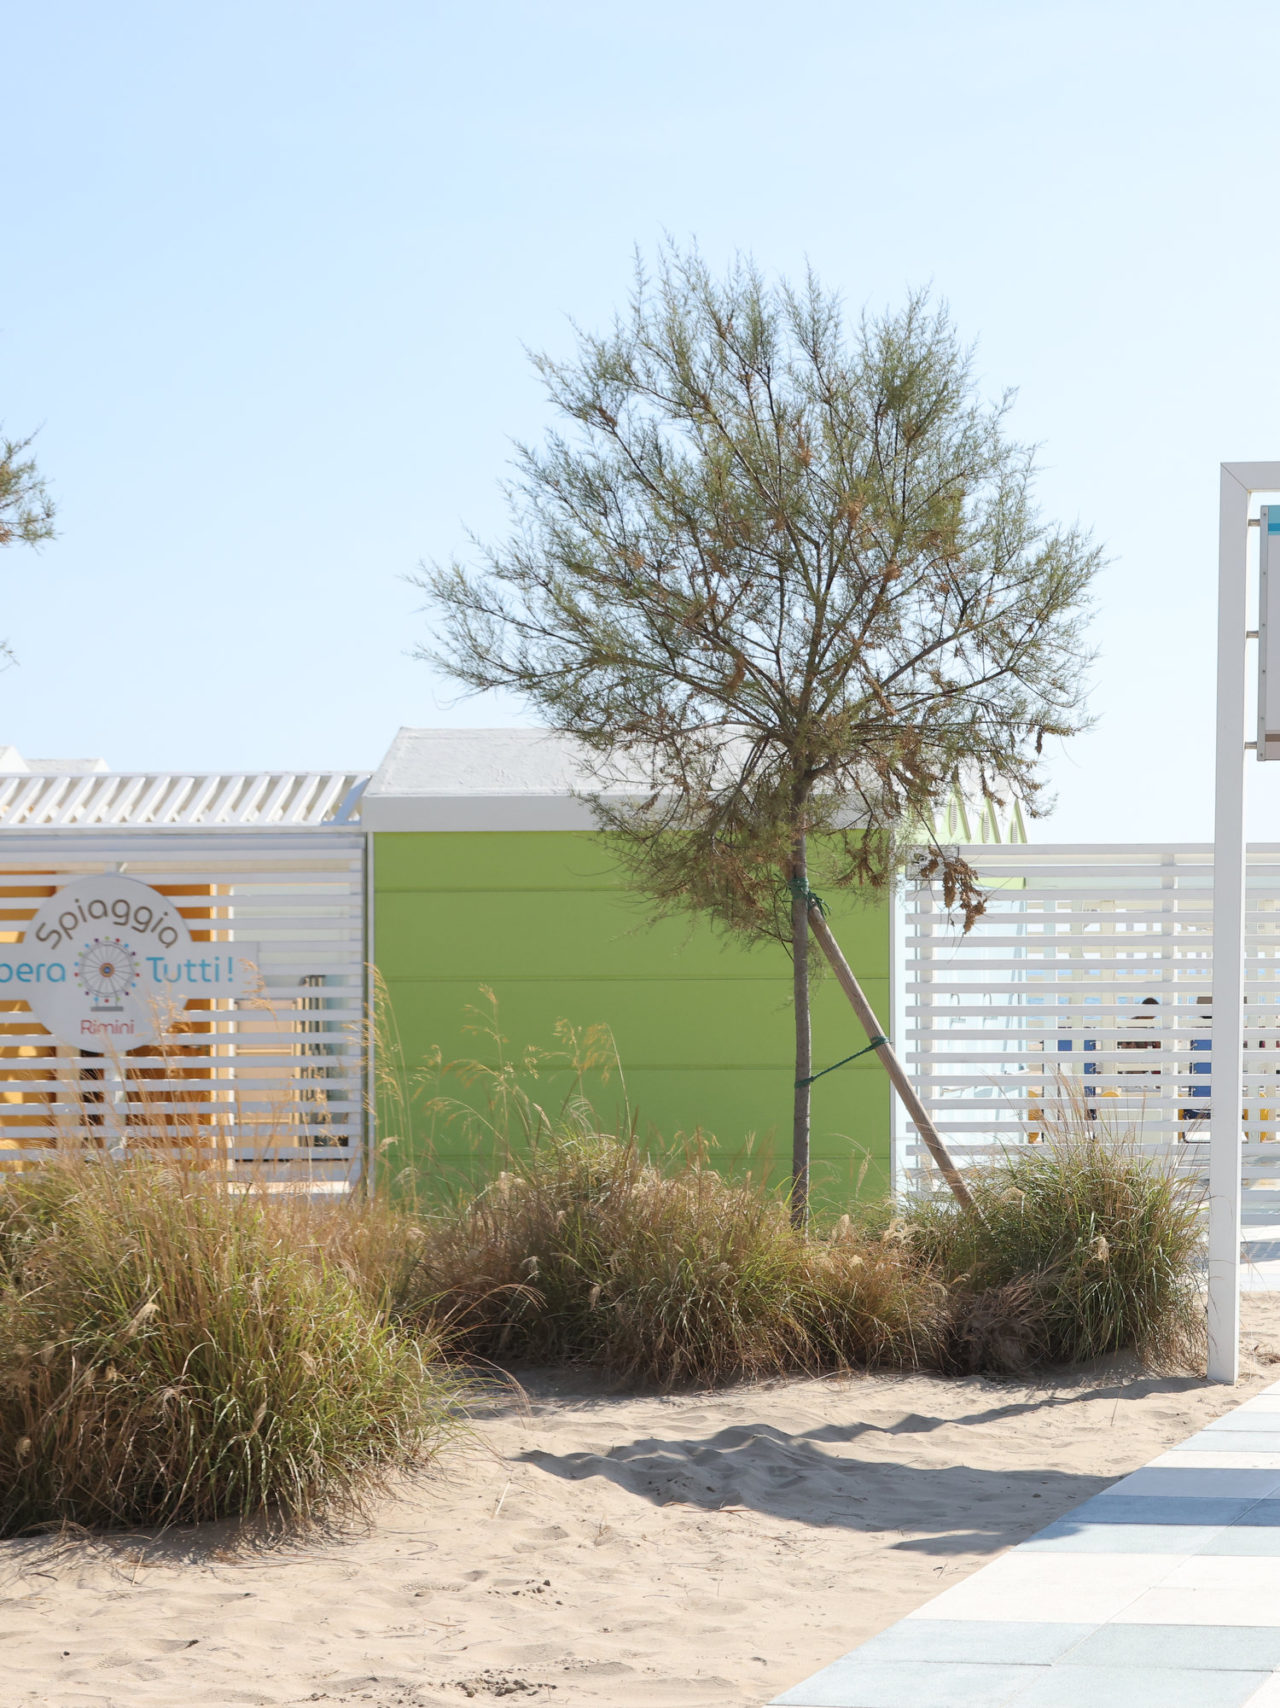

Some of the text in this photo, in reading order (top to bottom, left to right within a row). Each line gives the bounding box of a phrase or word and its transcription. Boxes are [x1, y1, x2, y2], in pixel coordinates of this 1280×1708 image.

[35, 898, 178, 950] Spiaggia
[0, 961, 66, 983] bera
[80, 1019, 134, 1035] Rimini
